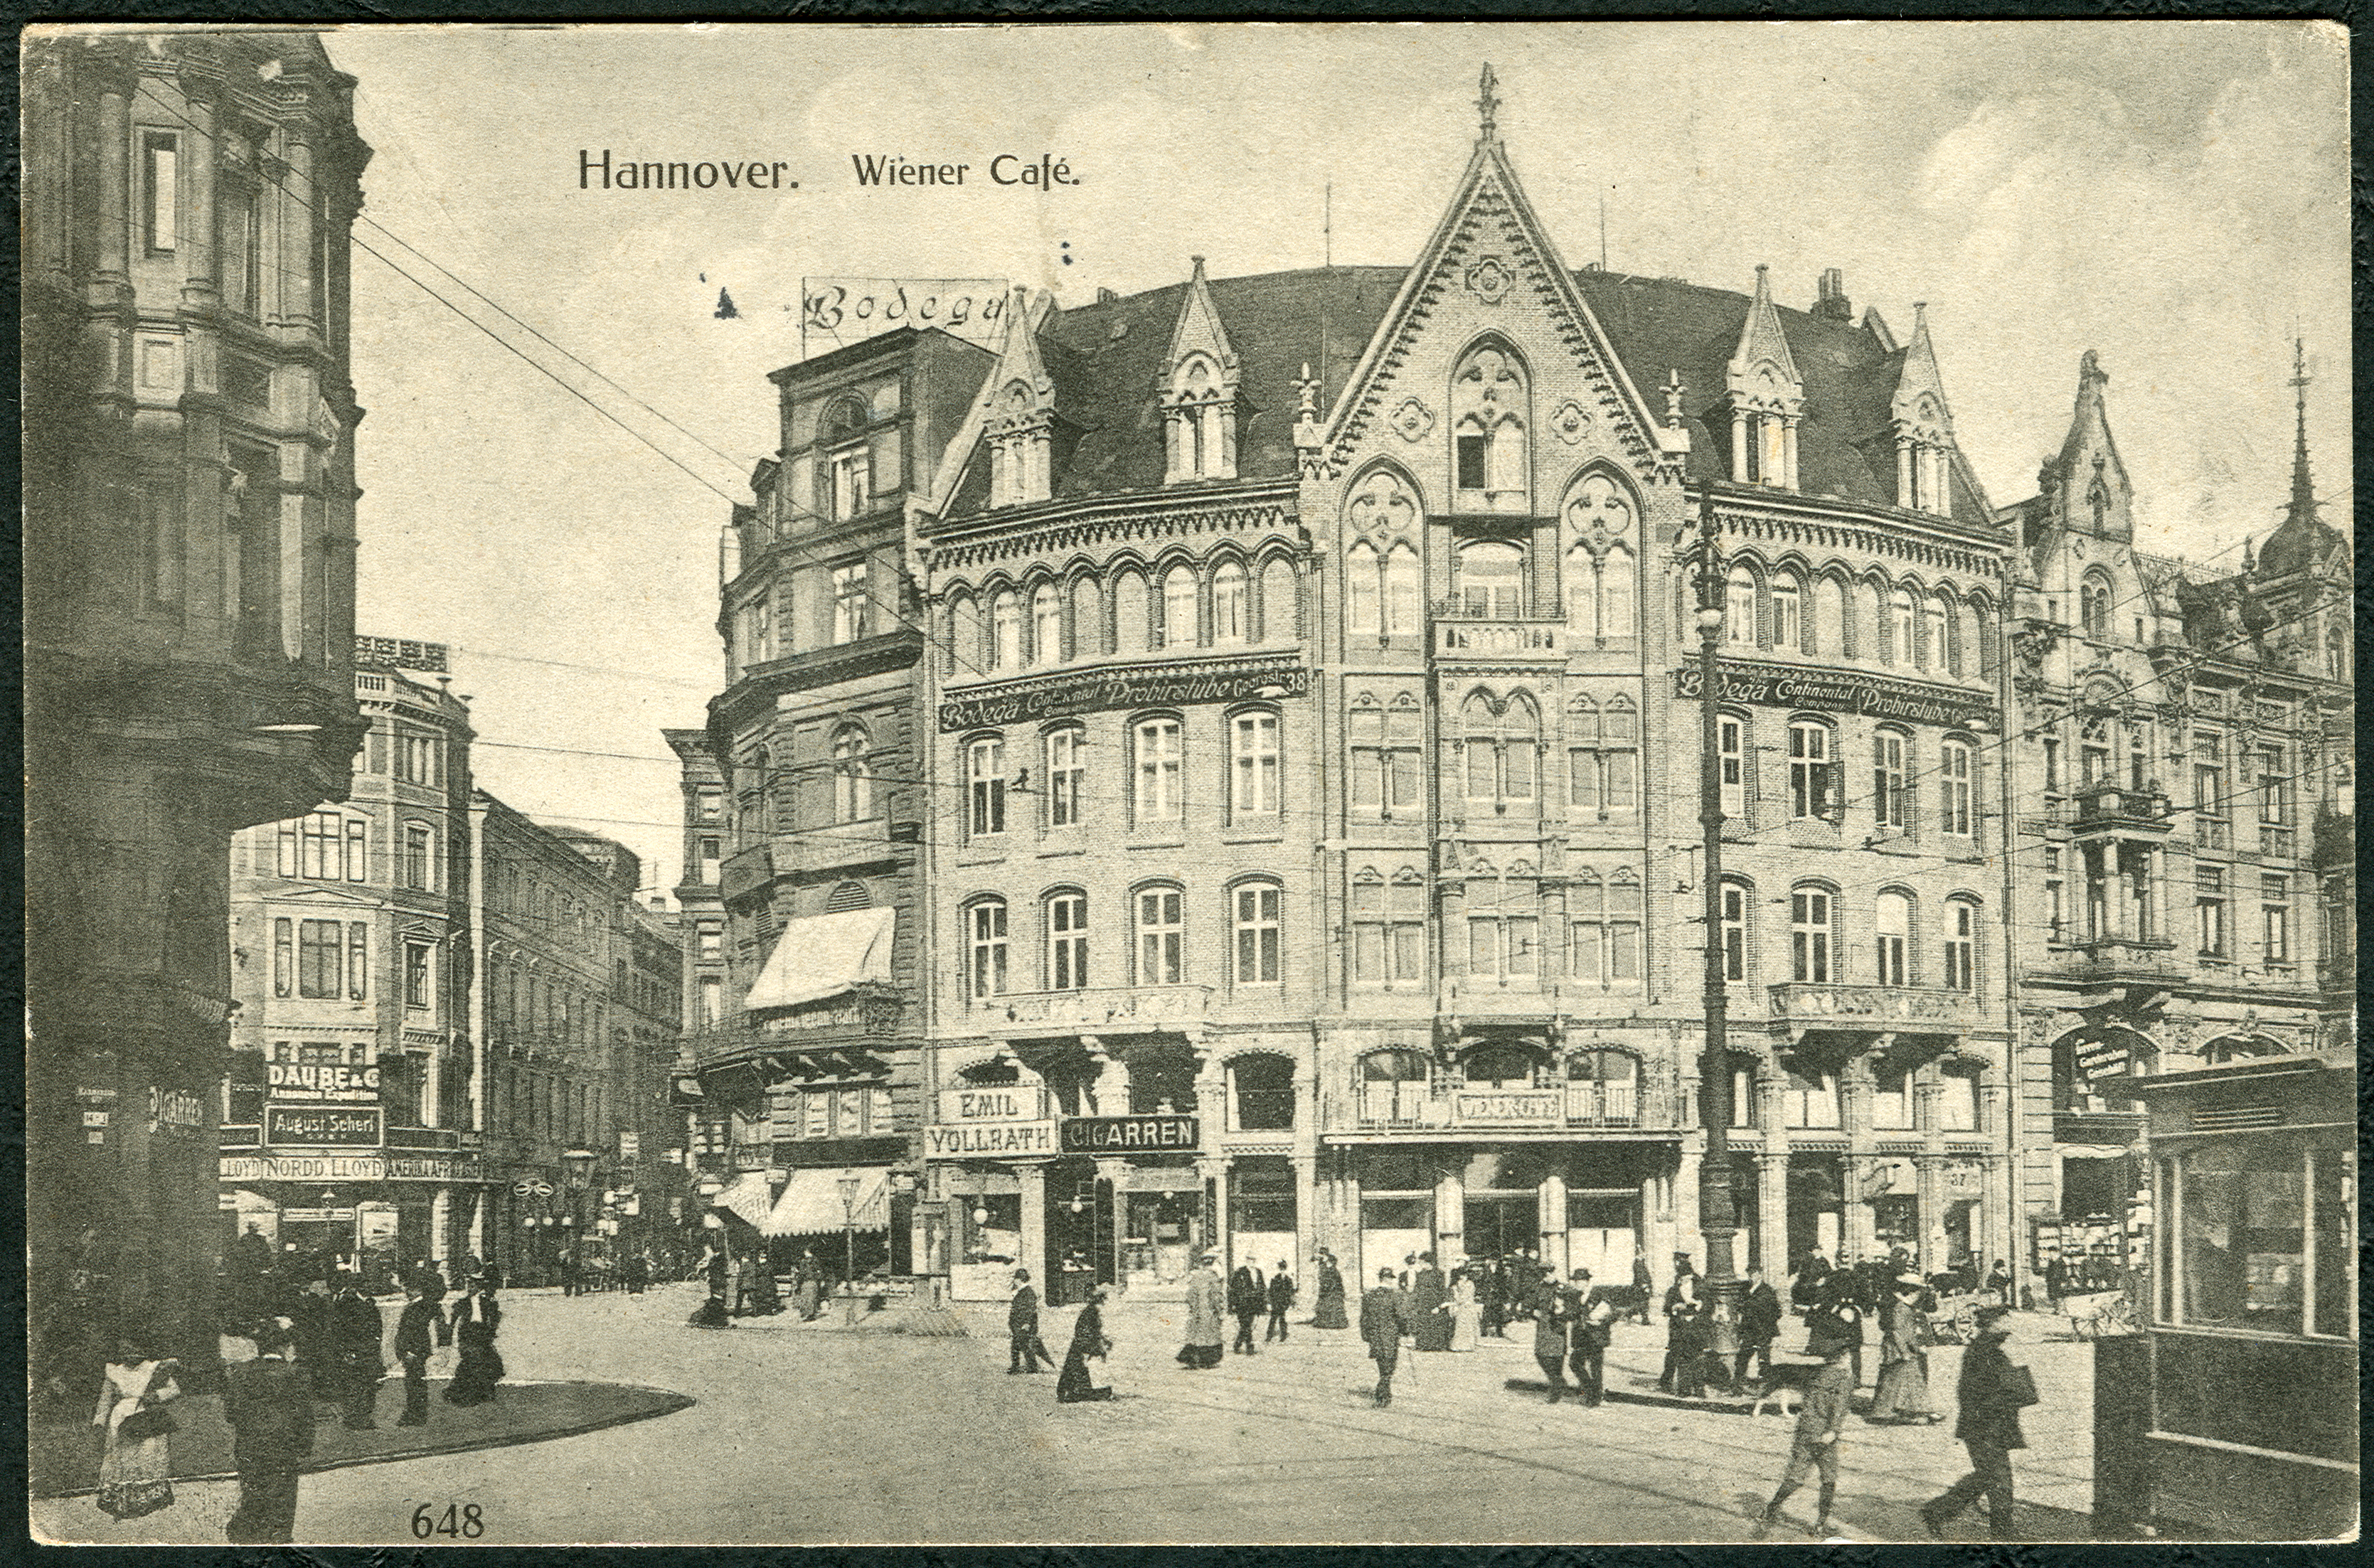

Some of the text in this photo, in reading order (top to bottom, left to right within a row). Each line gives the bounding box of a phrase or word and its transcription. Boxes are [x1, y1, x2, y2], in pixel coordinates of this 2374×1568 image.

[804, 286, 1008, 329] Bodega
[1680, 671, 1769, 702] Bdega
[1776, 680, 1856, 700] Continental
[942, 701, 1021, 730] Bodega
[1286, 672, 1306, 692] 38
[269, 1065, 350, 1089] DAUBE
[960, 1093, 1018, 1118] EMIL
[275, 1114, 373, 1135] August Scherl
[1070, 1121, 1193, 1146] CIGARREN
[928, 1126, 1052, 1153] VOLLRATH
[331, 1159, 383, 1177] LLOYD
